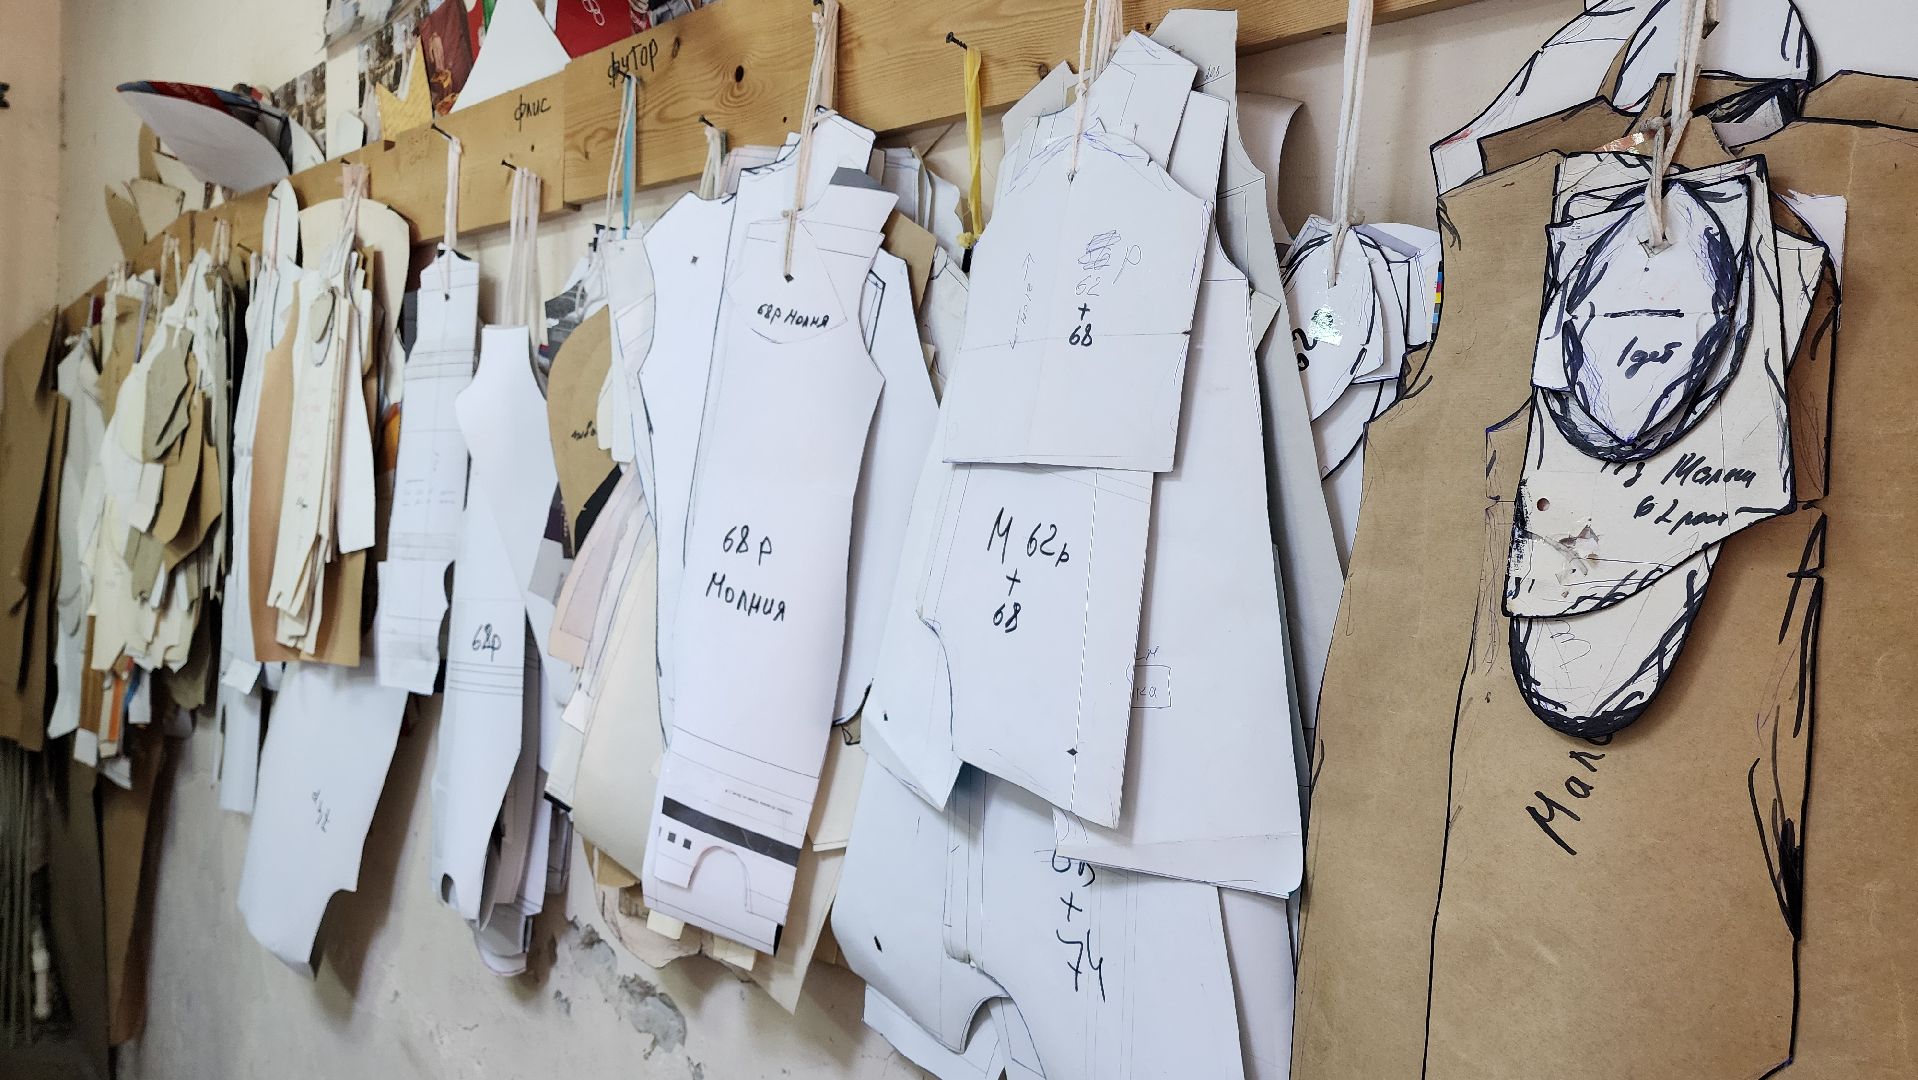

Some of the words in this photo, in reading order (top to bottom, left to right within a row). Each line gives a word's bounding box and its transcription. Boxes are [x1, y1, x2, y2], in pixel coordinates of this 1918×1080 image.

[1068, 323, 1093, 347] 68
[705, 571, 786, 622] Молния
[992, 601, 1022, 634] 68
[1056, 929, 1106, 1003] 74
